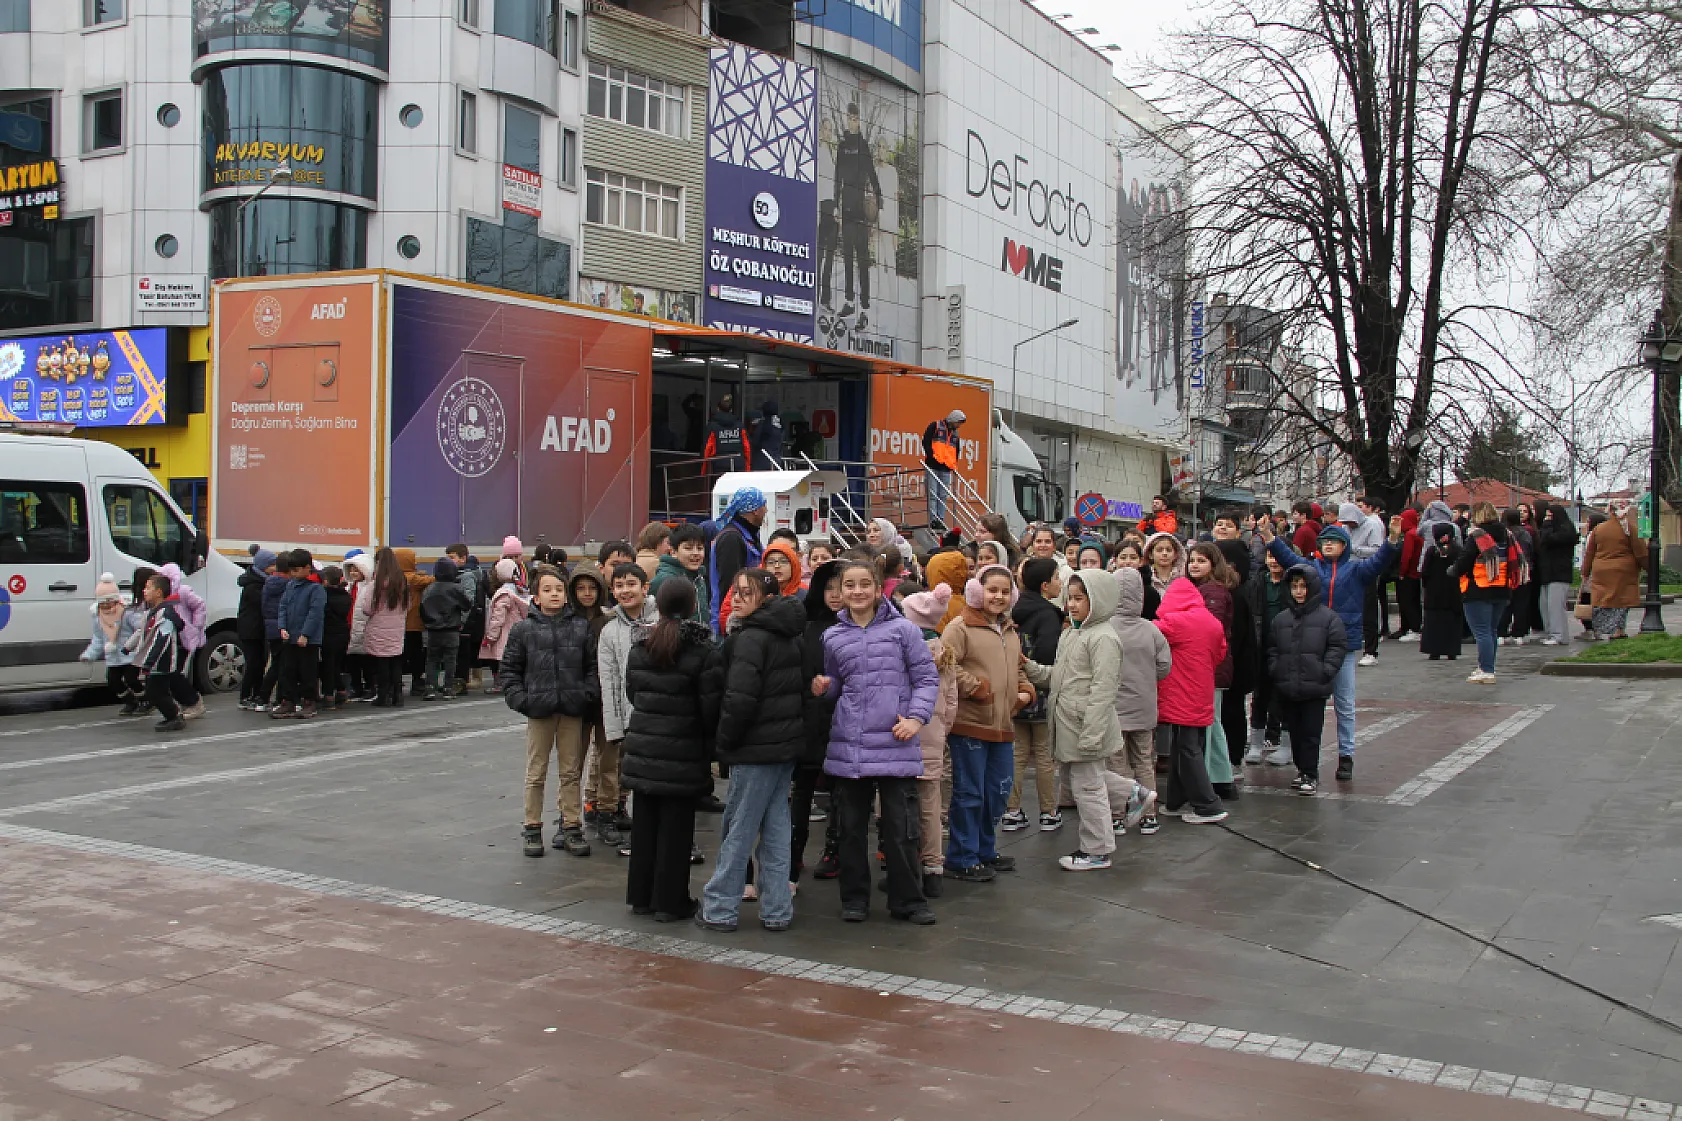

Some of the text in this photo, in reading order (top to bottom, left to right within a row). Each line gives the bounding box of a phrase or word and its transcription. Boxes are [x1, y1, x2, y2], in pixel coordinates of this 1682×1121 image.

[215, 141, 325, 164] AKVARYUM
[505, 167, 541, 187] SATILIK
[966, 128, 1092, 247] DeFacto
[755, 200, 769, 216] 50
[712, 226, 810, 259] MEŞHUR KÖFTECİ
[710, 249, 815, 289] ÖZ ÇOBANOĞLU
[1025, 246, 1064, 293] ME
[311, 303, 346, 321] AFAD
[848, 331, 893, 358] hummel
[231, 400, 304, 416] Depreme Karşı
[231, 416, 358, 432] Doğru Zemin, Sağlam Bina
[540, 414, 613, 454] AFAD
[870, 428, 926, 461] prem
